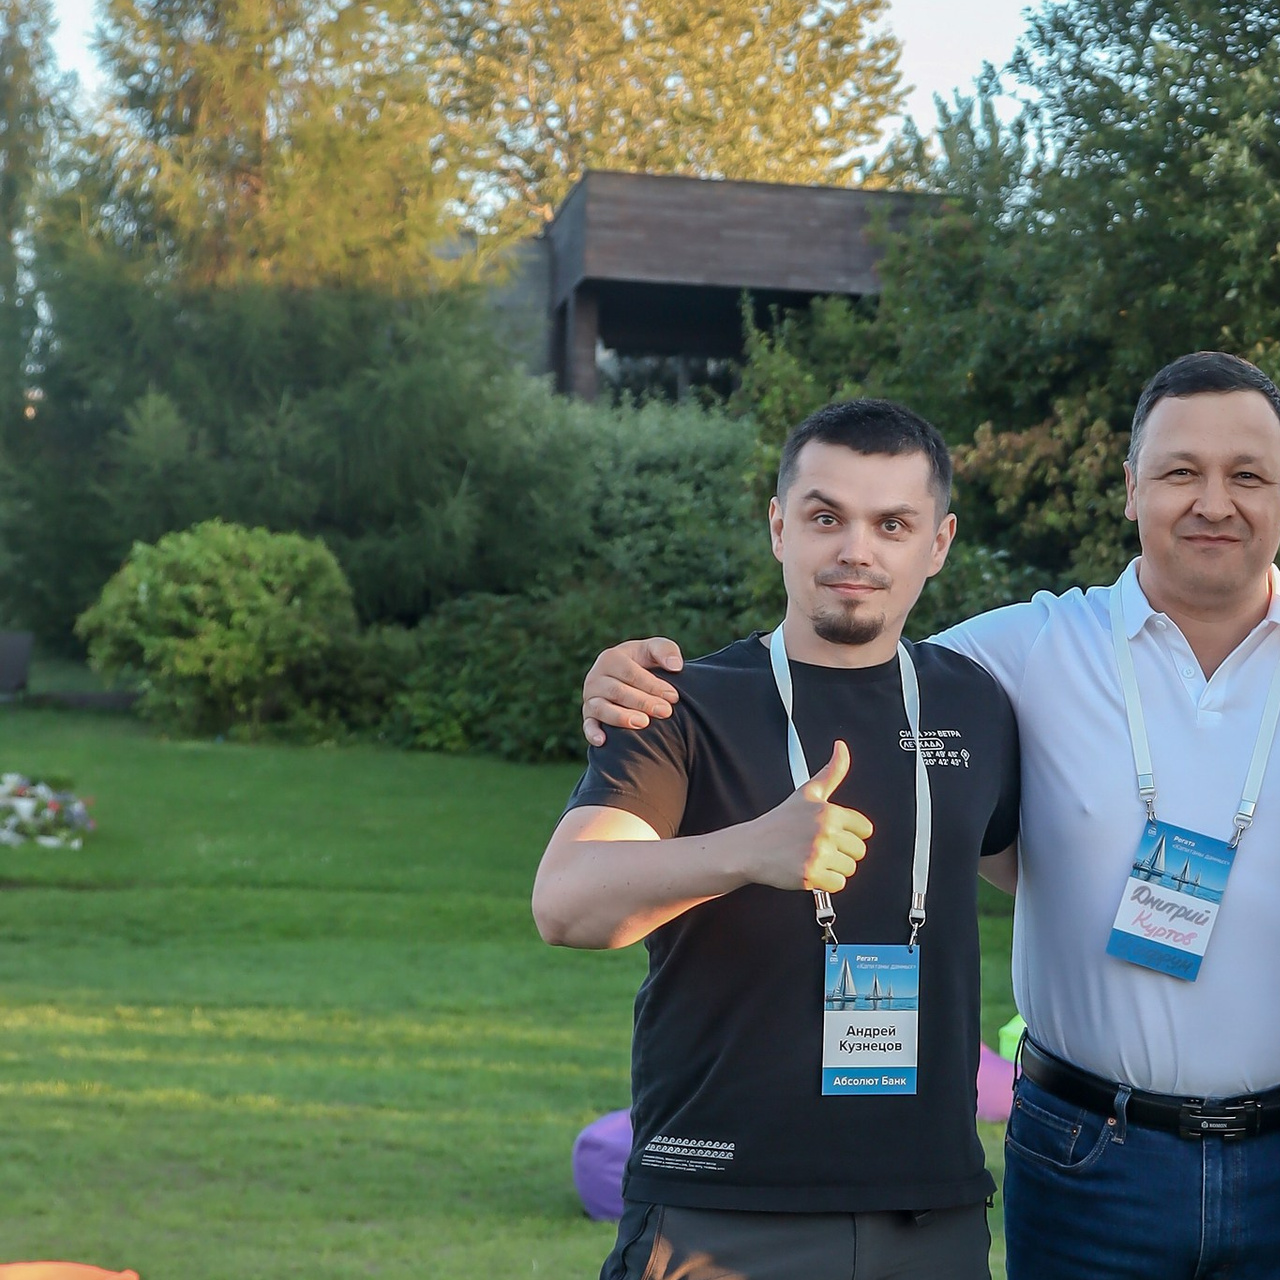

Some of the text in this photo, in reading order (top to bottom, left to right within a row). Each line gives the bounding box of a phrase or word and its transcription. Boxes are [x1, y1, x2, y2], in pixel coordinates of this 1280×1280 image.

[936, 730, 962, 738] ВЕТРА
[1173, 835, 1196, 847] Регата
[846, 1025, 896, 1039] Андрей
[839, 1040, 902, 1054] Кузнецов
[833, 1076, 907, 1086] Абсолют Банк
